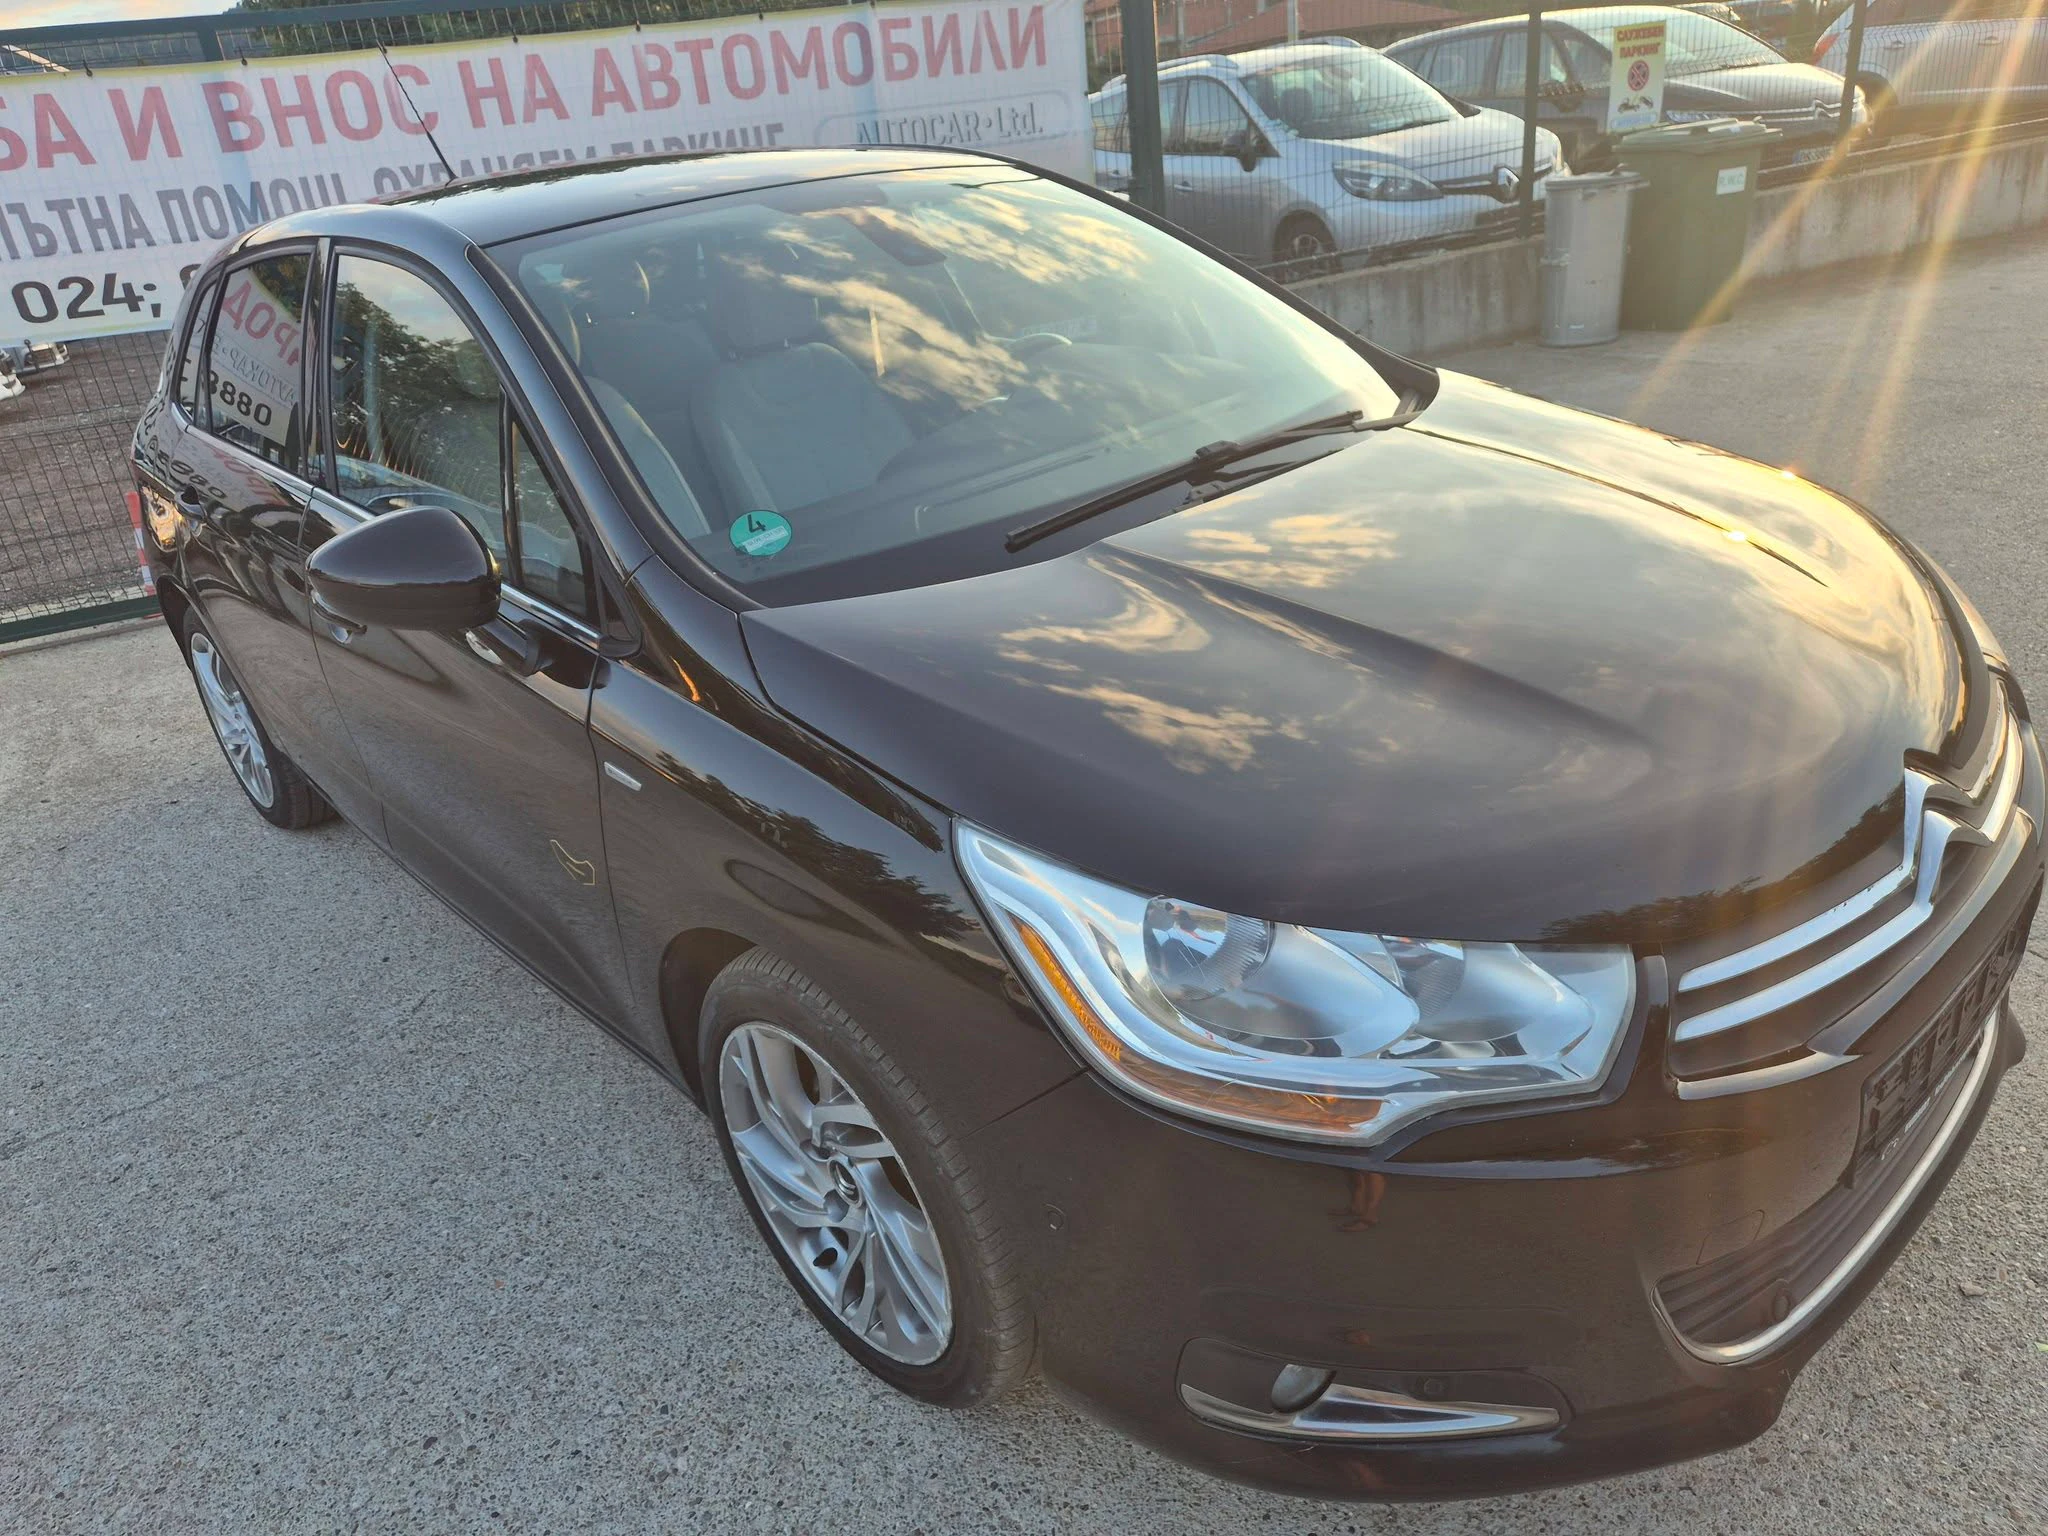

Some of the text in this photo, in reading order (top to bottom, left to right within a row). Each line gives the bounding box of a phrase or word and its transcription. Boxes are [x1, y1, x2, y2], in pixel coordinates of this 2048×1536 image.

[107, 86, 182, 161] И
[202, 64, 439, 153] ВНОС
[456, 54, 570, 129] НА
[591, 5, 1048, 117] АВТОМОБИЛИ
[747, 514, 766, 533] 4
